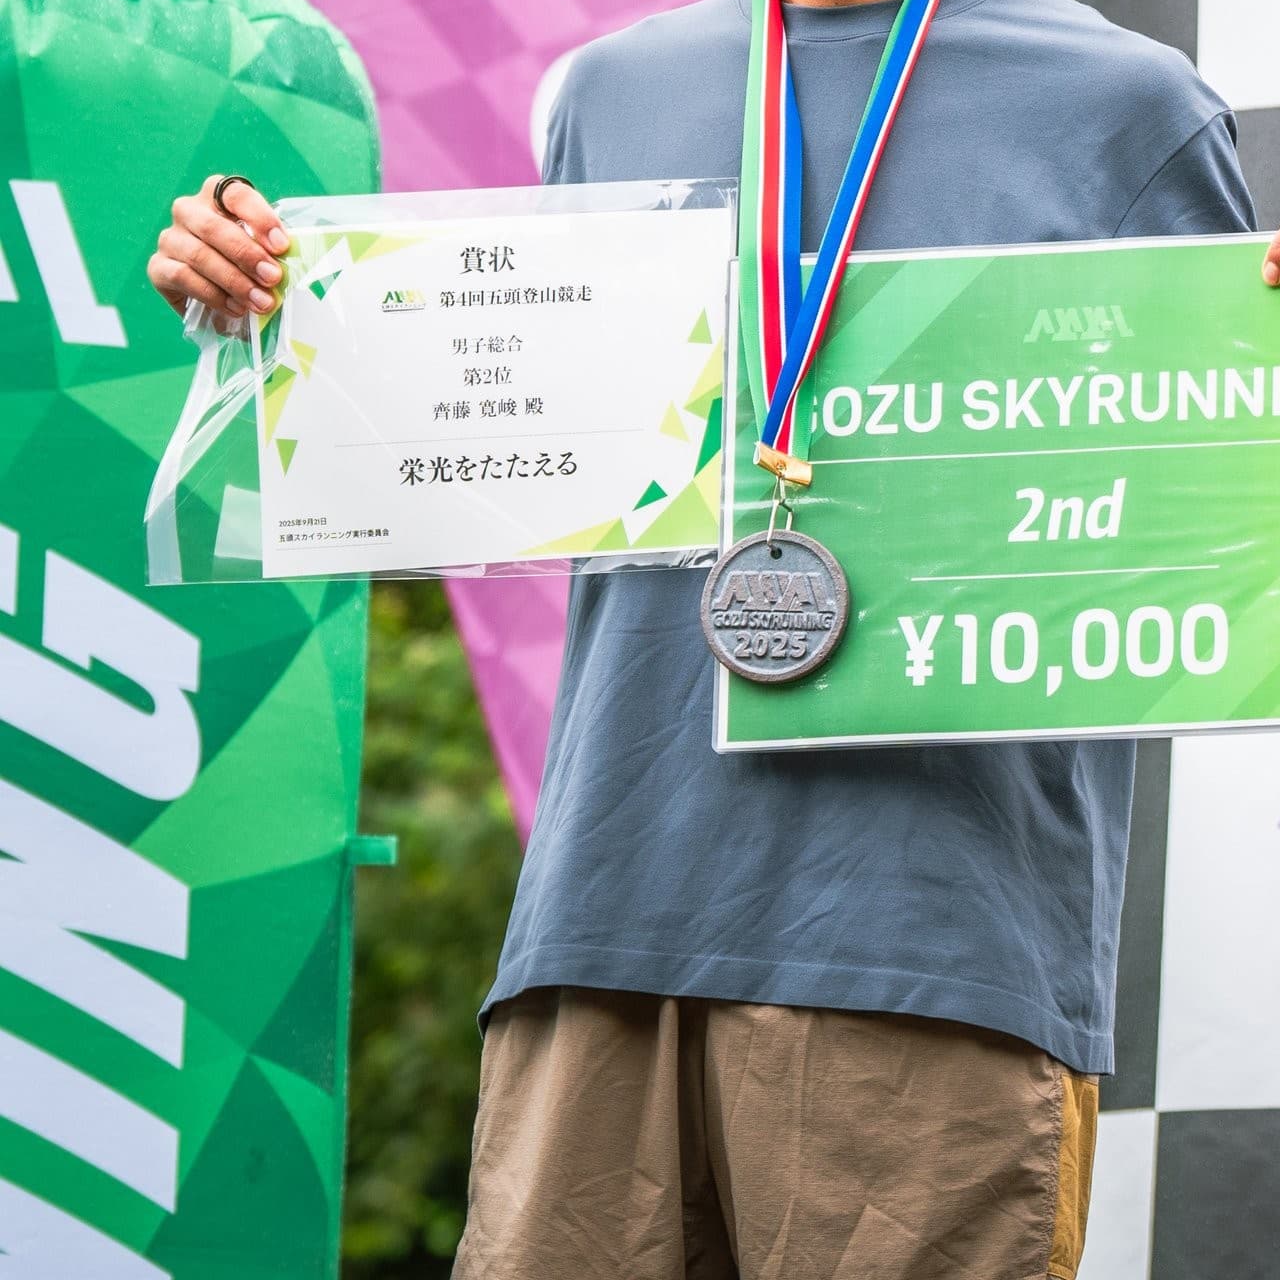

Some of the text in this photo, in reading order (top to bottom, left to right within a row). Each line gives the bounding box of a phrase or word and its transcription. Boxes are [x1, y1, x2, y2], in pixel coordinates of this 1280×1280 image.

[459, 245, 516, 275] 賞状
[439, 285, 593, 308] 第4回五頭登山競走
[452, 335, 523, 356] 男子総合
[463, 367, 513, 386] 第2位
[524, 397, 544, 416] 殿
[809, 381, 943, 438] OZU
[399, 451, 578, 487] 栄光をたたえる
[1007, 477, 1128, 545] 2nd
[733, 630, 808, 659] 2025
[899, 603, 1230, 697] ¥10,000
